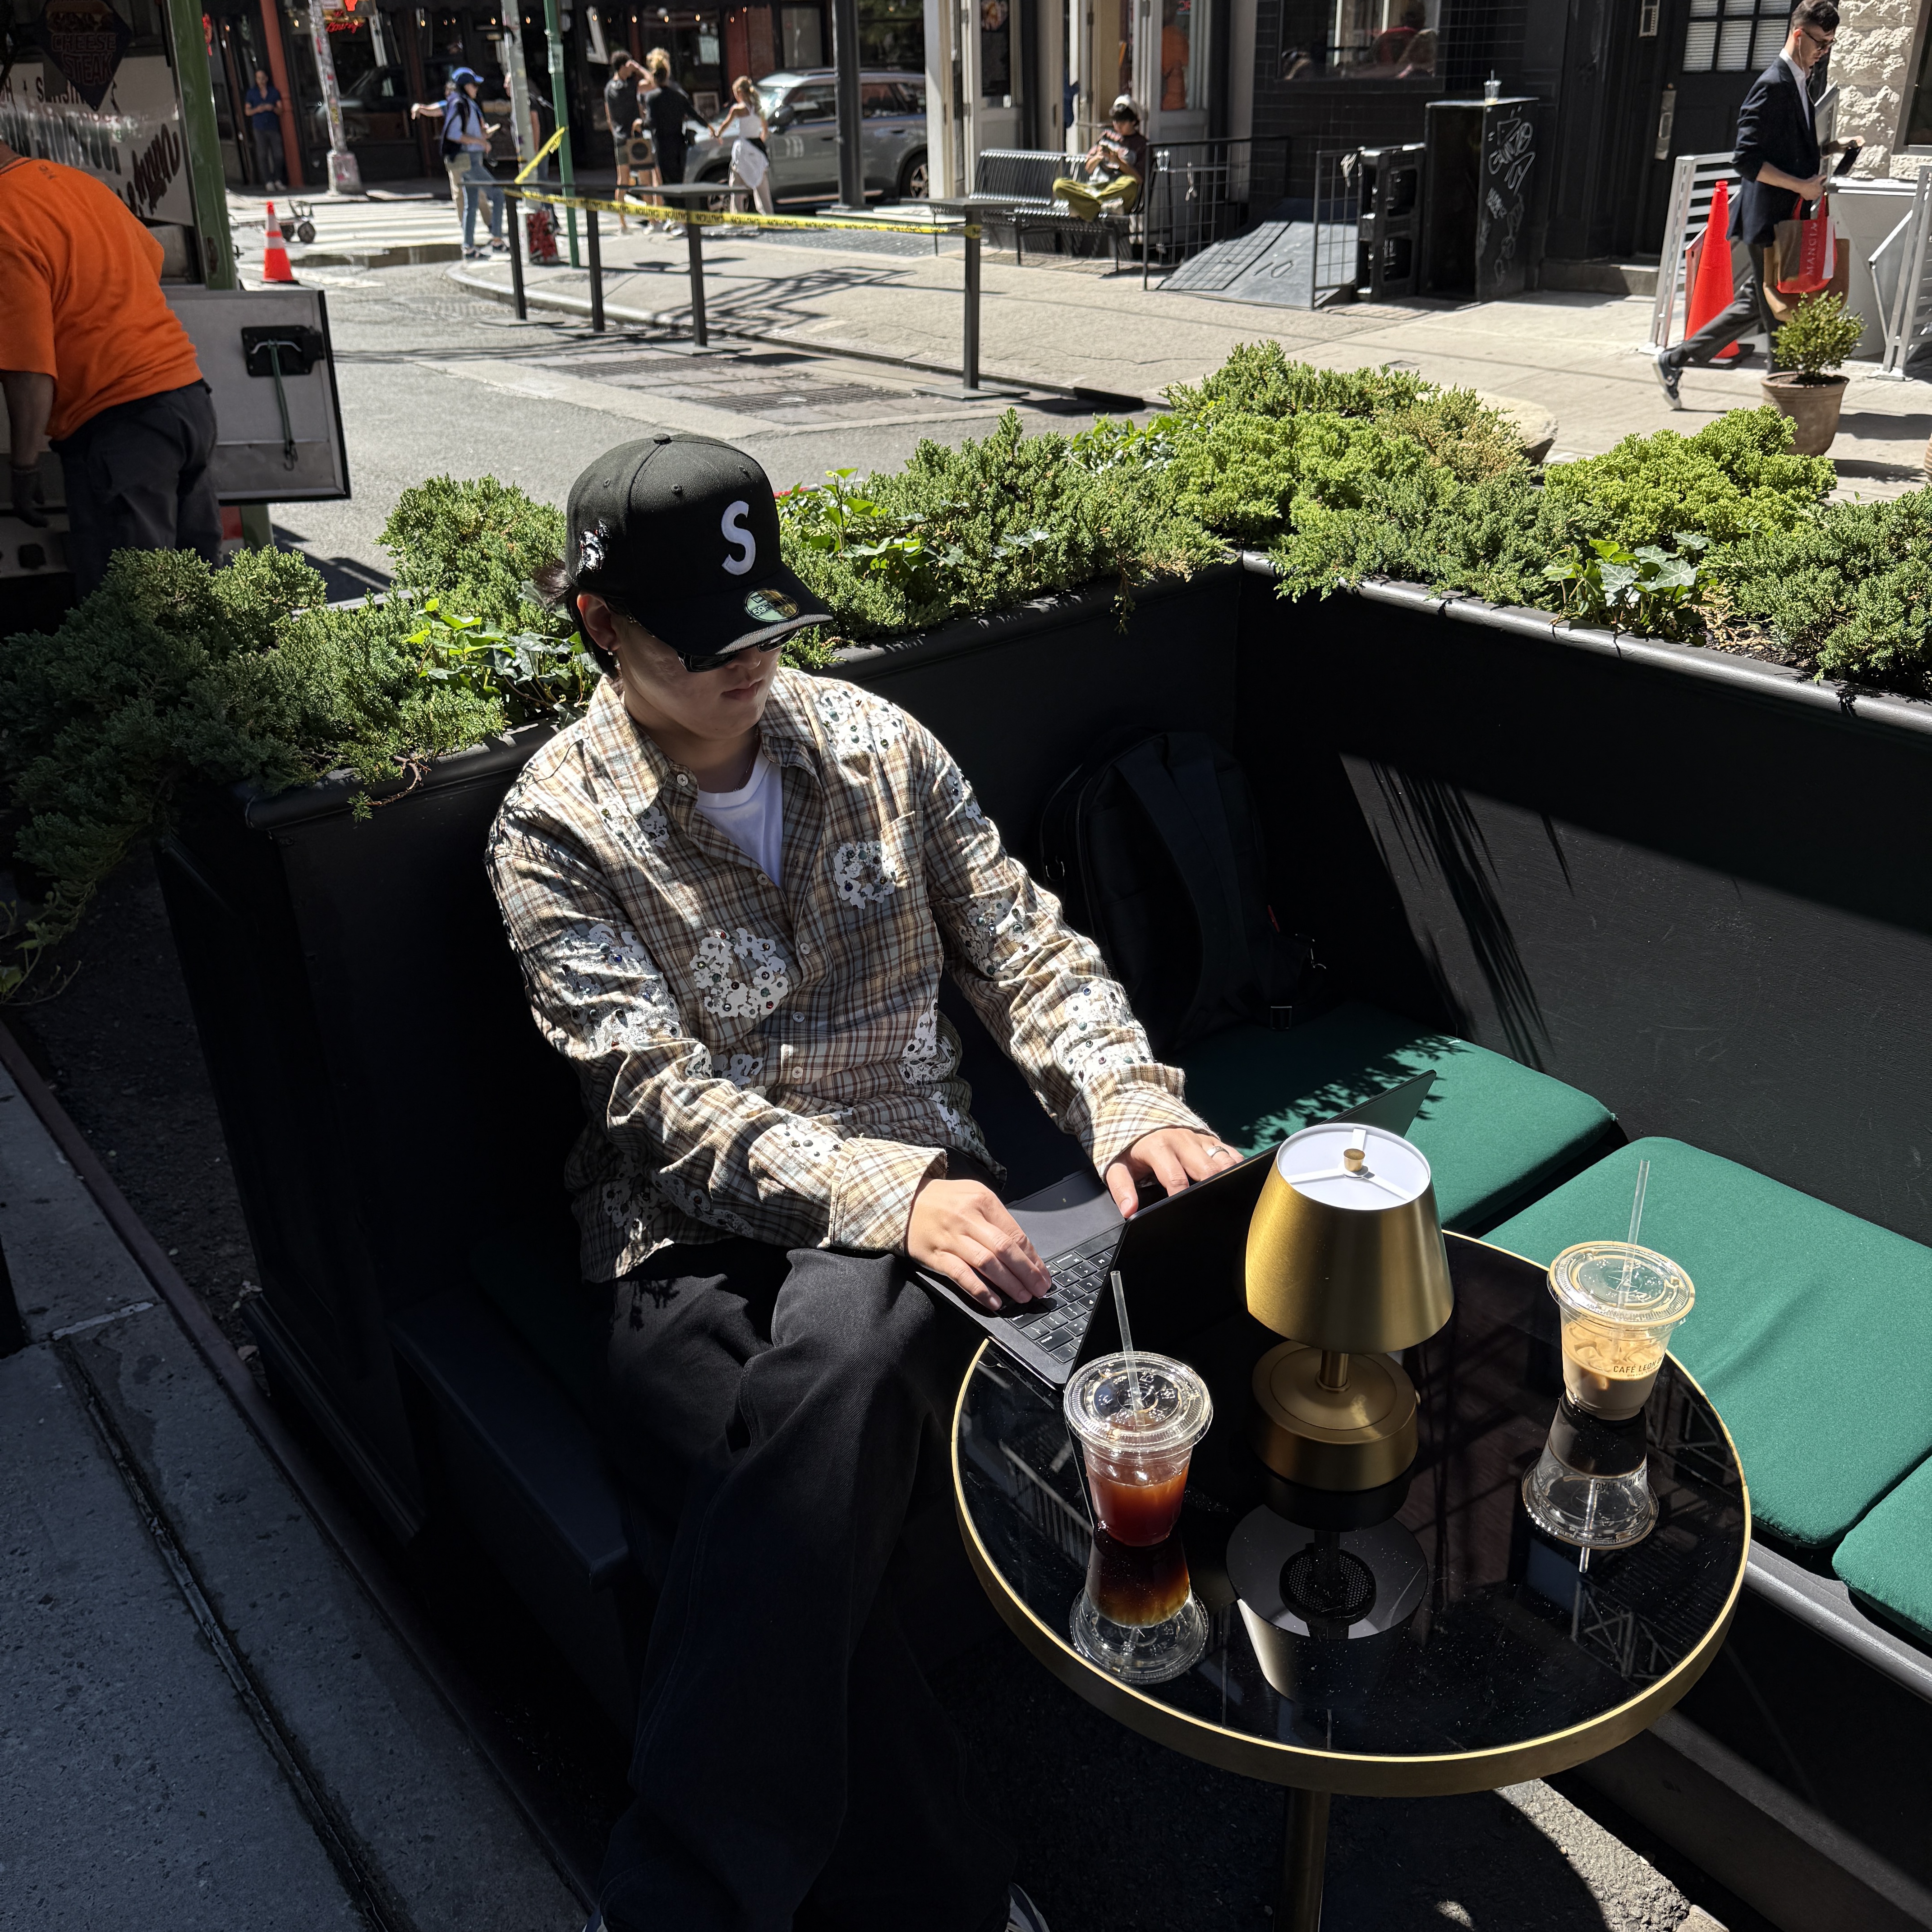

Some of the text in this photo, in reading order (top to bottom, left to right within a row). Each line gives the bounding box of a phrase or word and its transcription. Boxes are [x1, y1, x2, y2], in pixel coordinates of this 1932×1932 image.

[51, 33, 117, 52] CHEESE
[62, 52, 113, 85] STEAK
[1804, 222, 1818, 276] MANGIA
[722, 500, 756, 575] S
[1613, 1364, 1636, 1373] CAFÉ
[1638, 1360, 1656, 1372] LEON
